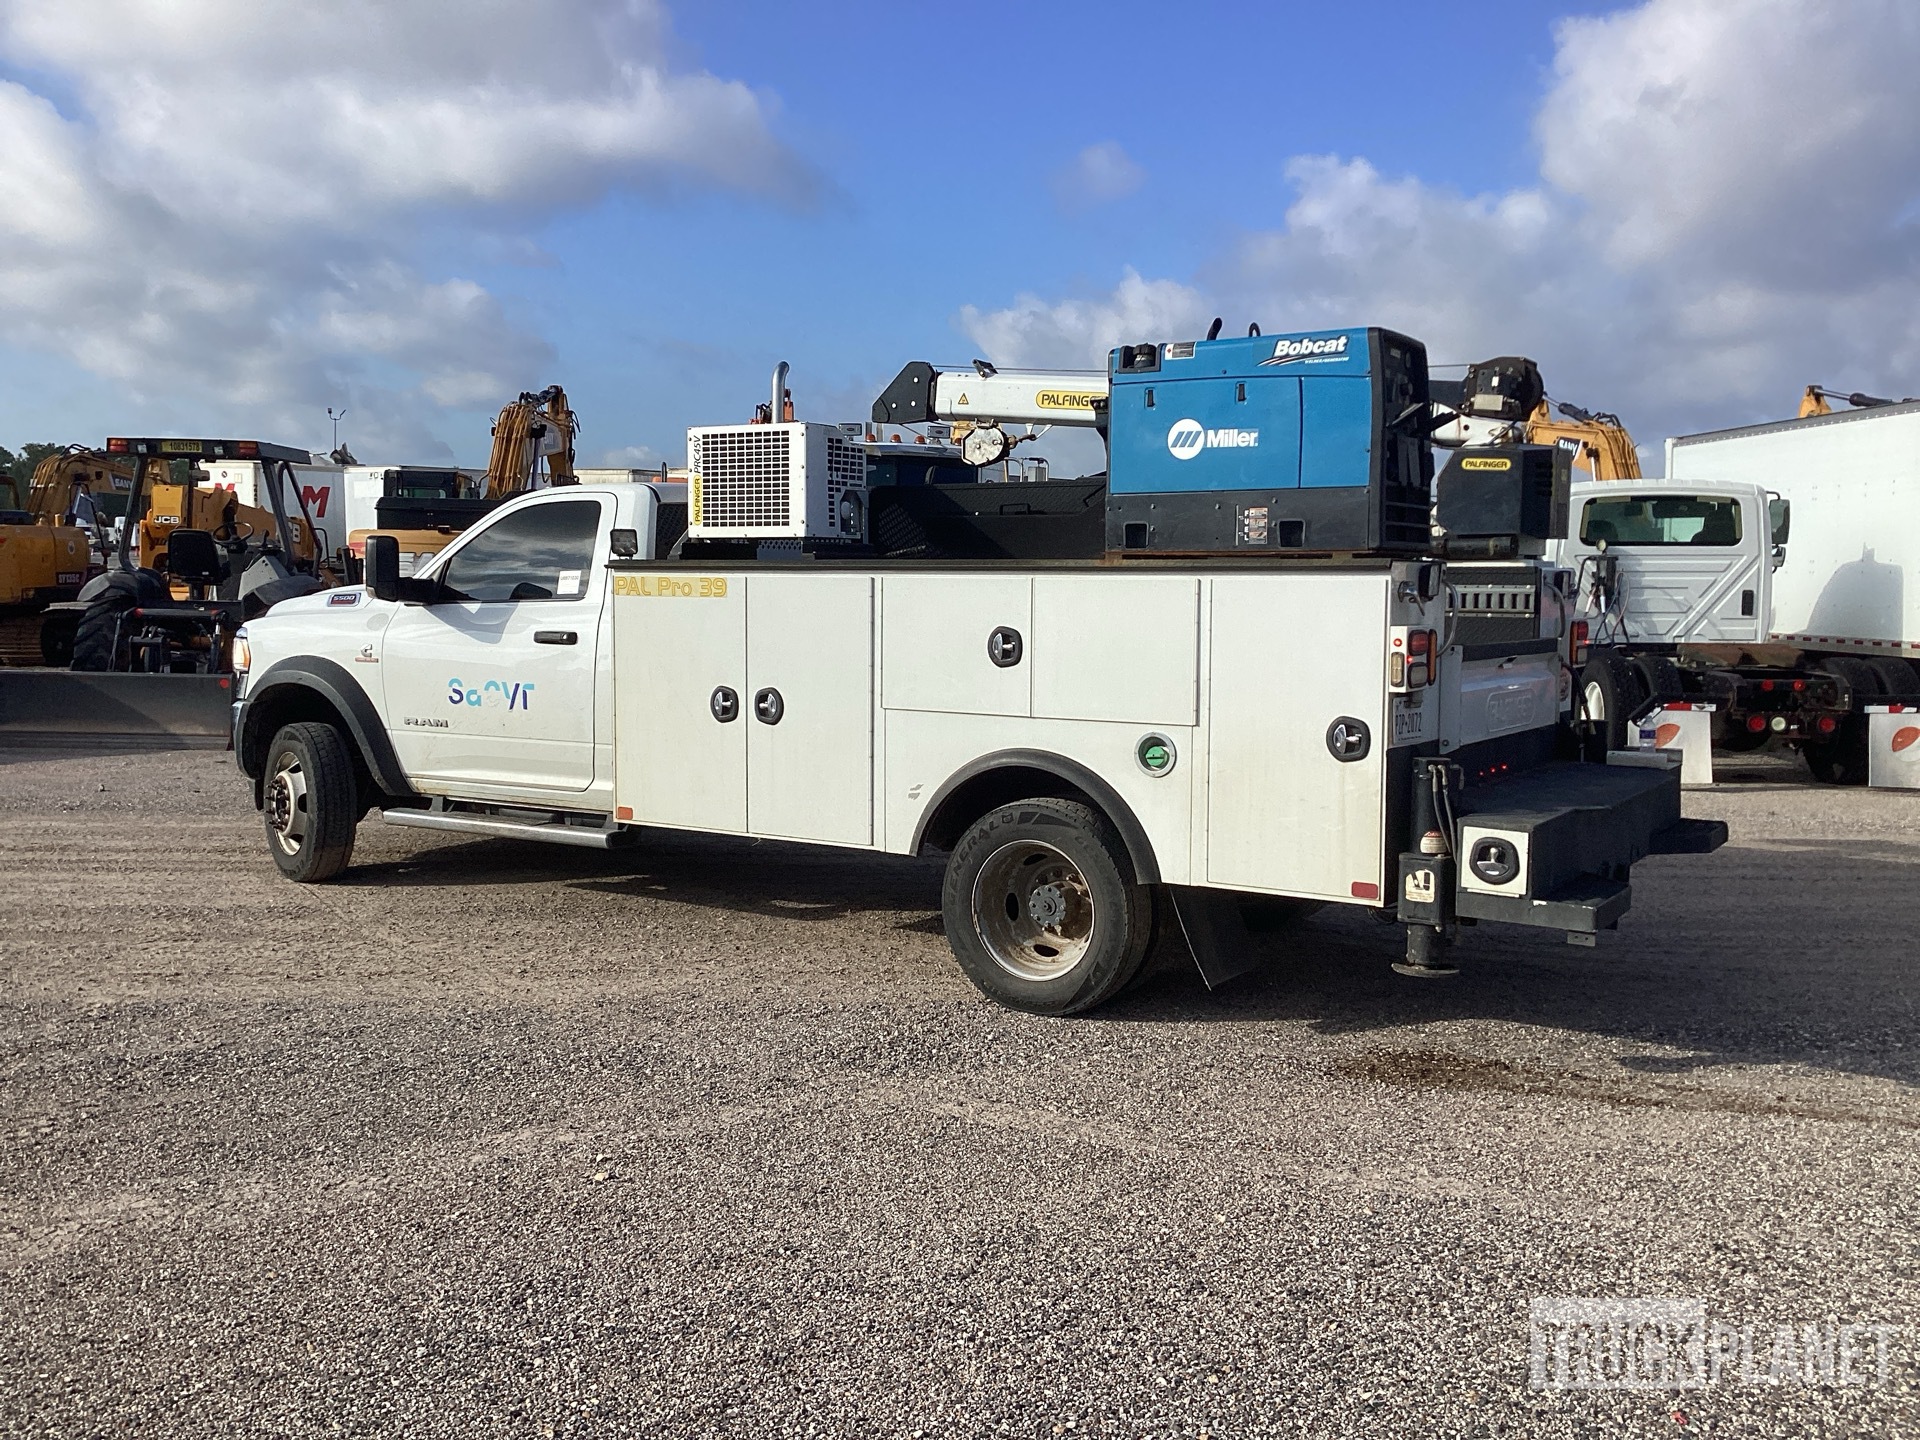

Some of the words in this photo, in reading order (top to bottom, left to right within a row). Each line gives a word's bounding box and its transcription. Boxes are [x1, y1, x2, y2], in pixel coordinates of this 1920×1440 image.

[1275, 335, 1348, 357] Bobcat
[1041, 393, 1091, 407] PALFING
[693, 434, 701, 474] PRC45V
[1465, 460, 1508, 469] PALFINGER
[154, 516, 180, 524] JCB
[615, 576, 652, 597] PAL
[658, 577, 693, 597] Pro
[700, 577, 728, 598] 39
[403, 716, 449, 729] RAM
